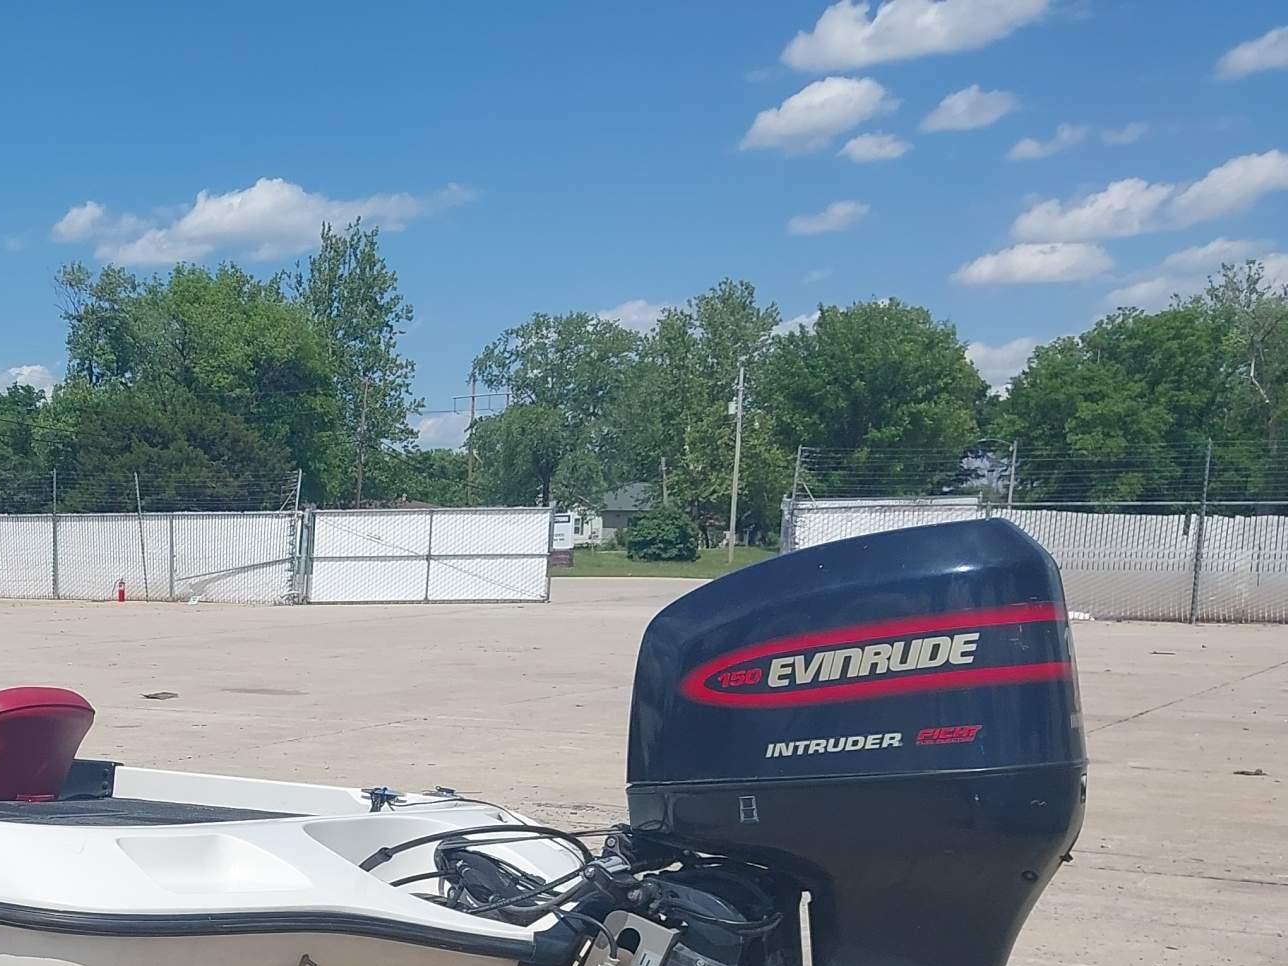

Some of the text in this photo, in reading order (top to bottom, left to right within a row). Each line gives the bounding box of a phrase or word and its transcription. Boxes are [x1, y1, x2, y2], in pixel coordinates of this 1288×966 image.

[718, 632, 980, 688] 150 EVINRUDE
[765, 732, 903, 758] INTRUDER
